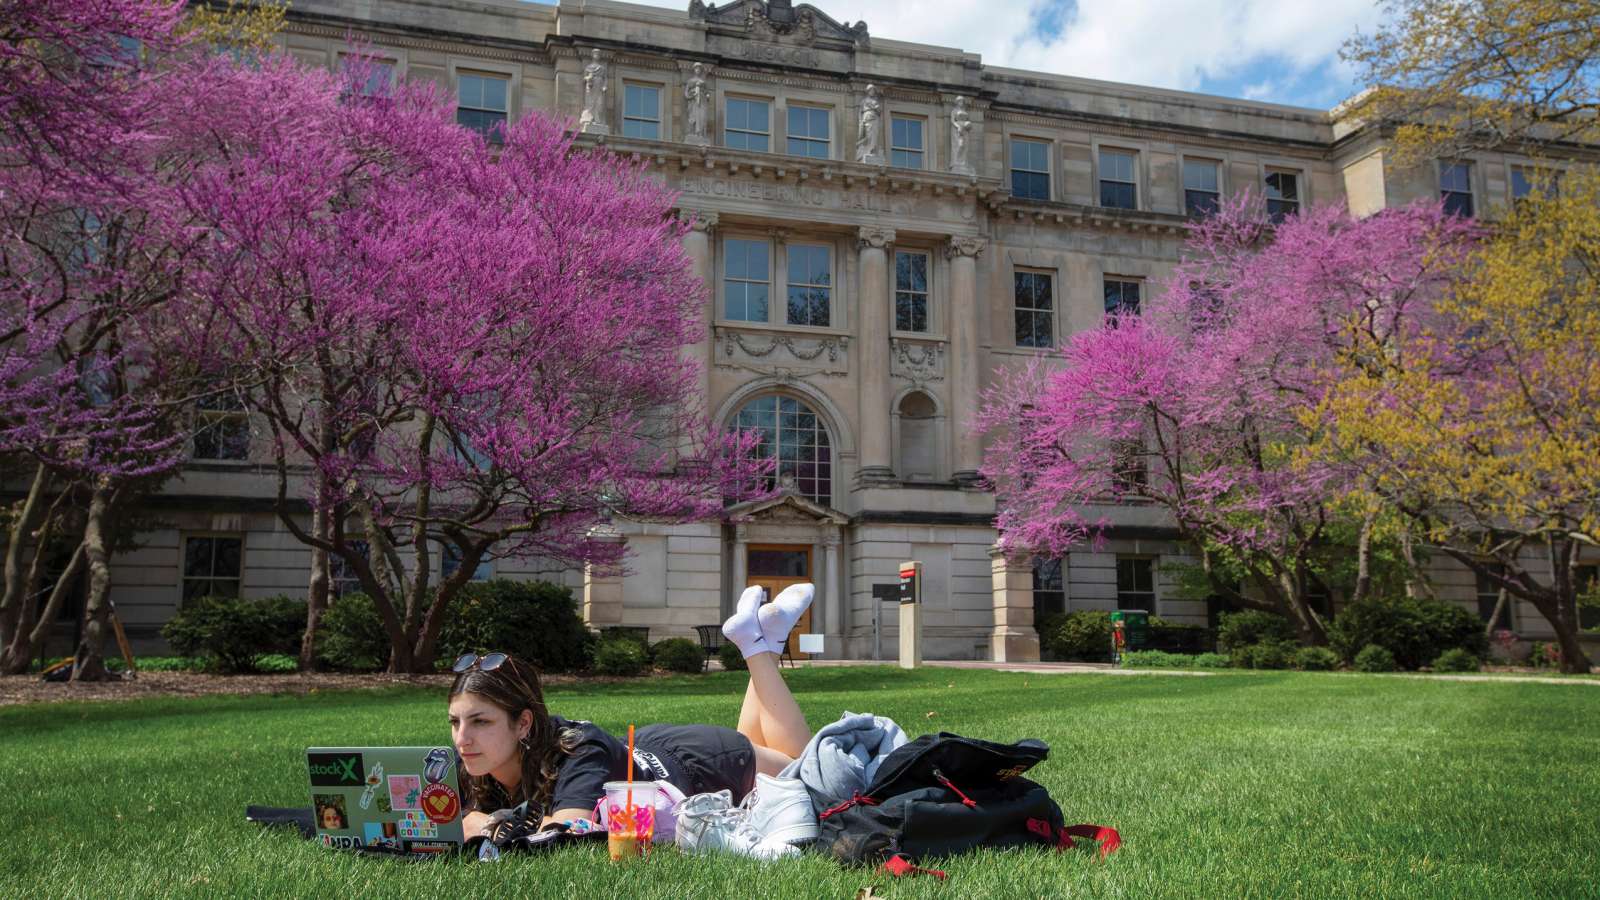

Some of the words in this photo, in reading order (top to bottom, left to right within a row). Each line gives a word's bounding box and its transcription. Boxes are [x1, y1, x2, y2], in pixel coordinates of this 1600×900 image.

[681, 176, 823, 206] ENGINEERING
[310, 756, 359, 782] stockX
[422, 784, 456, 799] VACCINATED
[400, 828, 437, 837] COUNTY
